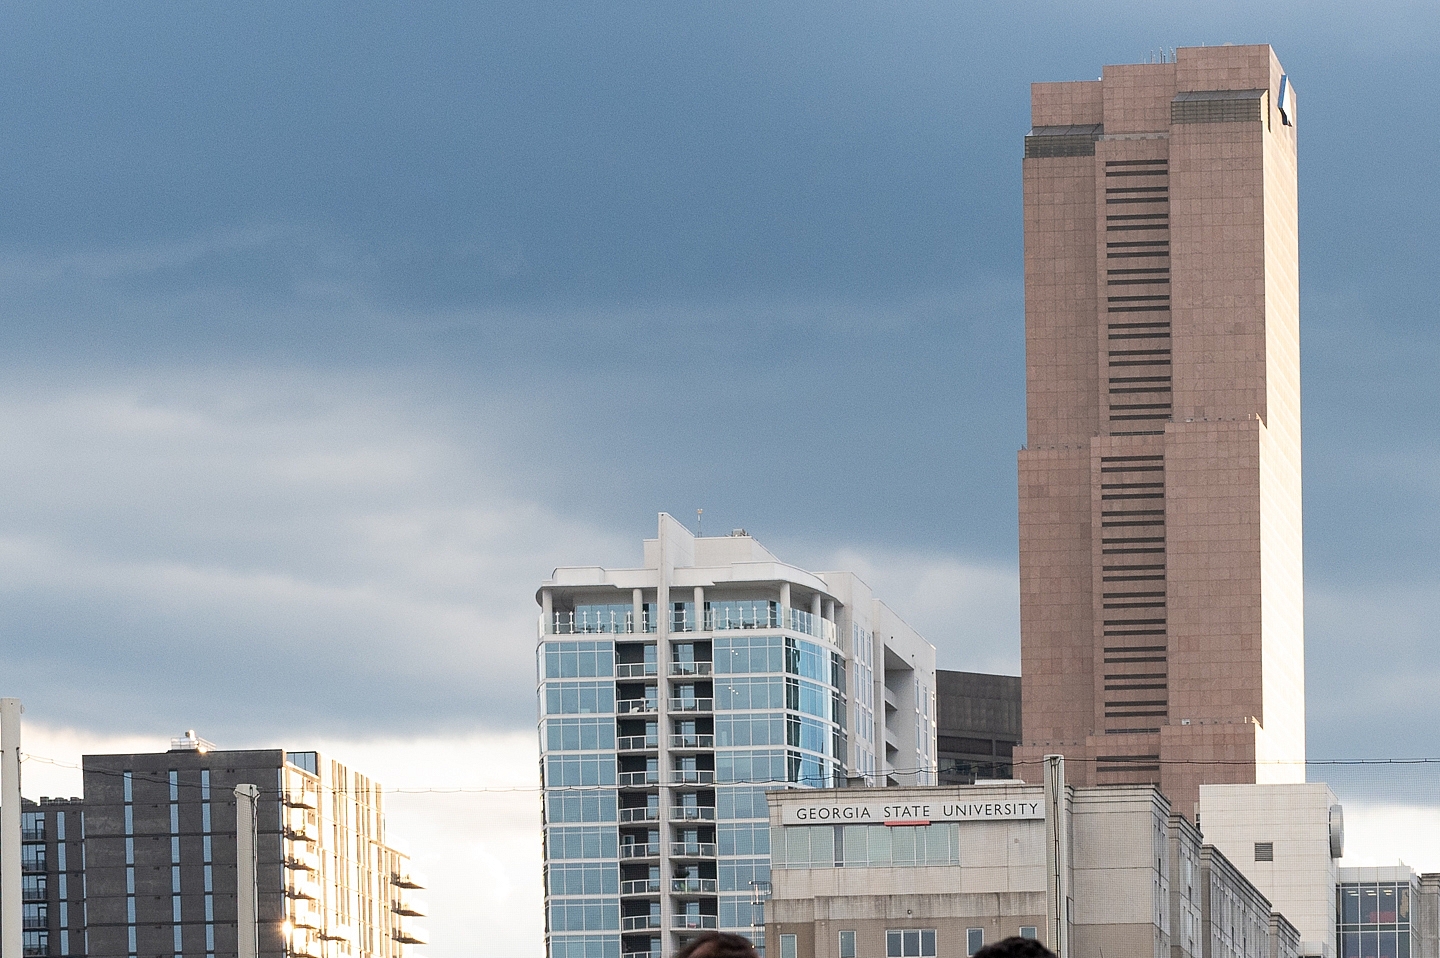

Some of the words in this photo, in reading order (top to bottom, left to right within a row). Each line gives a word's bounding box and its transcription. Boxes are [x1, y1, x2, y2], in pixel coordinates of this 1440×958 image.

[796, 806, 871, 820] GEORGIA
[883, 805, 930, 818] STATE
[943, 802, 1038, 817] UNIVERSITY
